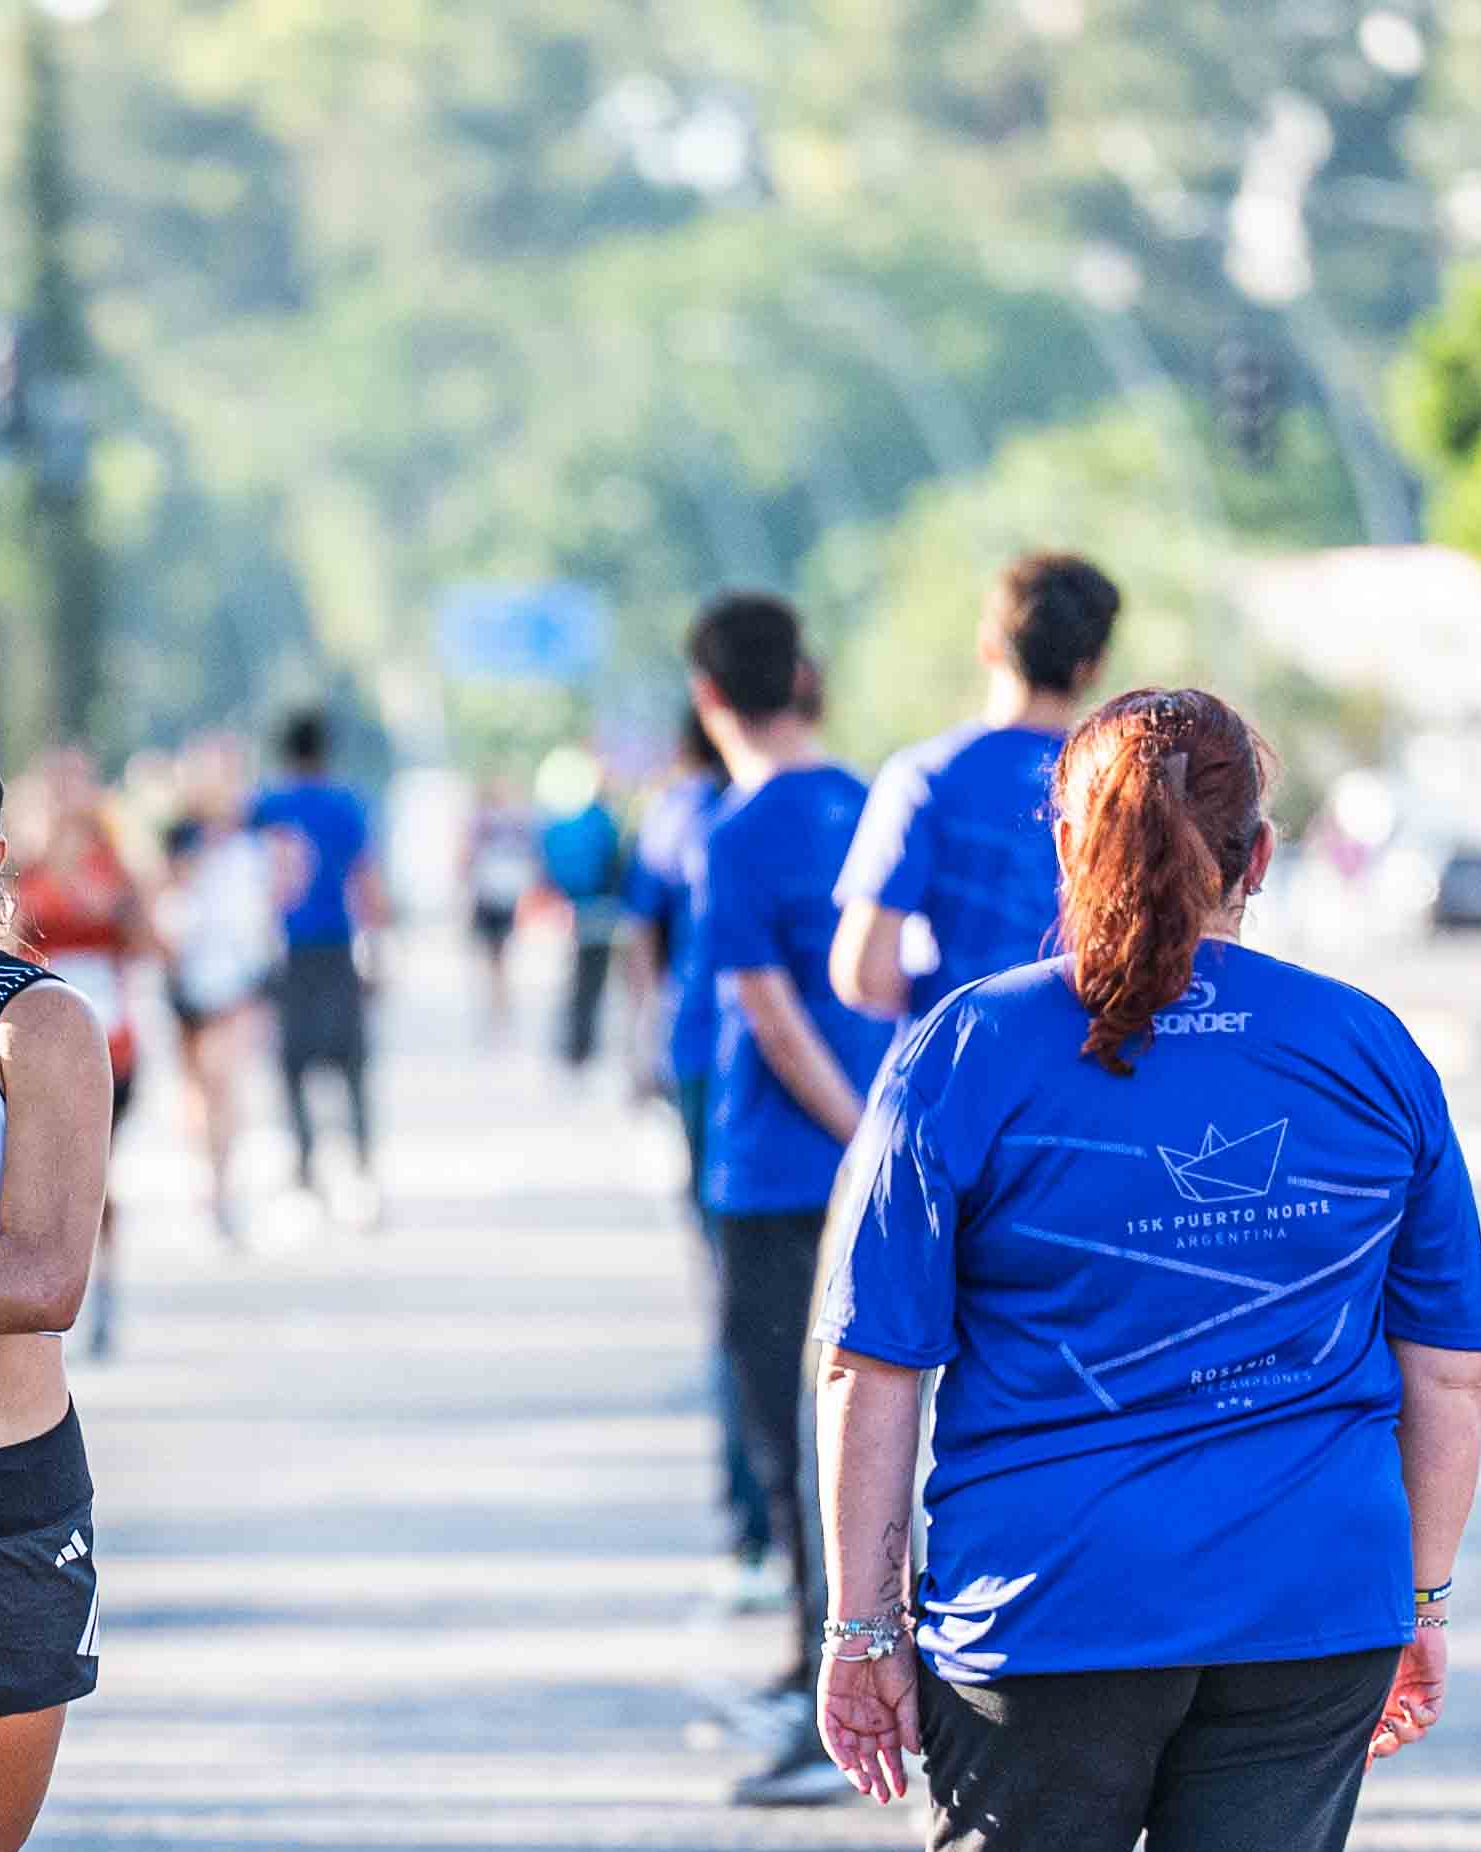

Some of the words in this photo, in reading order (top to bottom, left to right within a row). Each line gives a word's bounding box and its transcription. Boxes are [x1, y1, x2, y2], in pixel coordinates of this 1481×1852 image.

[1126, 1217, 1164, 1236] 15K
[1173, 1208, 1256, 1230] PUERTO
[1267, 1199, 1331, 1221] NORTE
[1175, 1227, 1287, 1249] ARGENTINA
